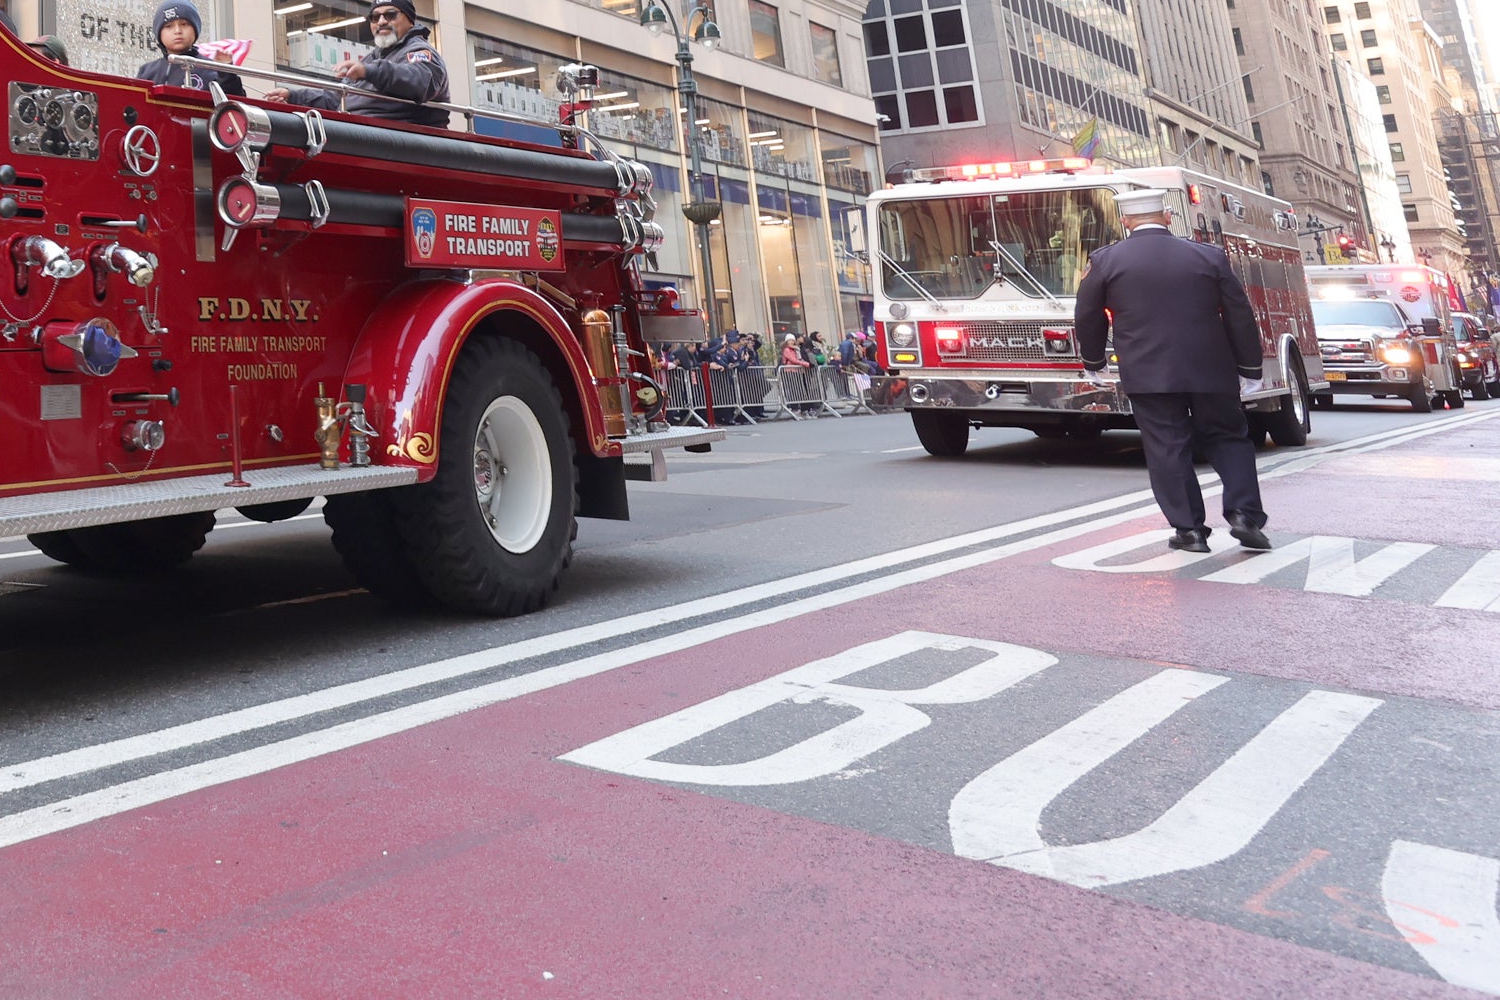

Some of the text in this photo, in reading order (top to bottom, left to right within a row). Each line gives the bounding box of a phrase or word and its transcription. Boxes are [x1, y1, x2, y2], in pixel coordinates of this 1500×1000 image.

[165, 8, 176, 19] 65
[81, 13, 159, 51] OF THE
[444, 214, 477, 233] FIRE
[482, 216, 529, 235] FAMILY
[447, 237, 530, 257] TRANSPORT
[198, 297, 319, 320] F.D.N.Y.
[191, 336, 326, 352] FIRE FAMILY TRANSPORT
[969, 337, 1045, 348] MACK
[228, 363, 298, 381] FOUNDATION
